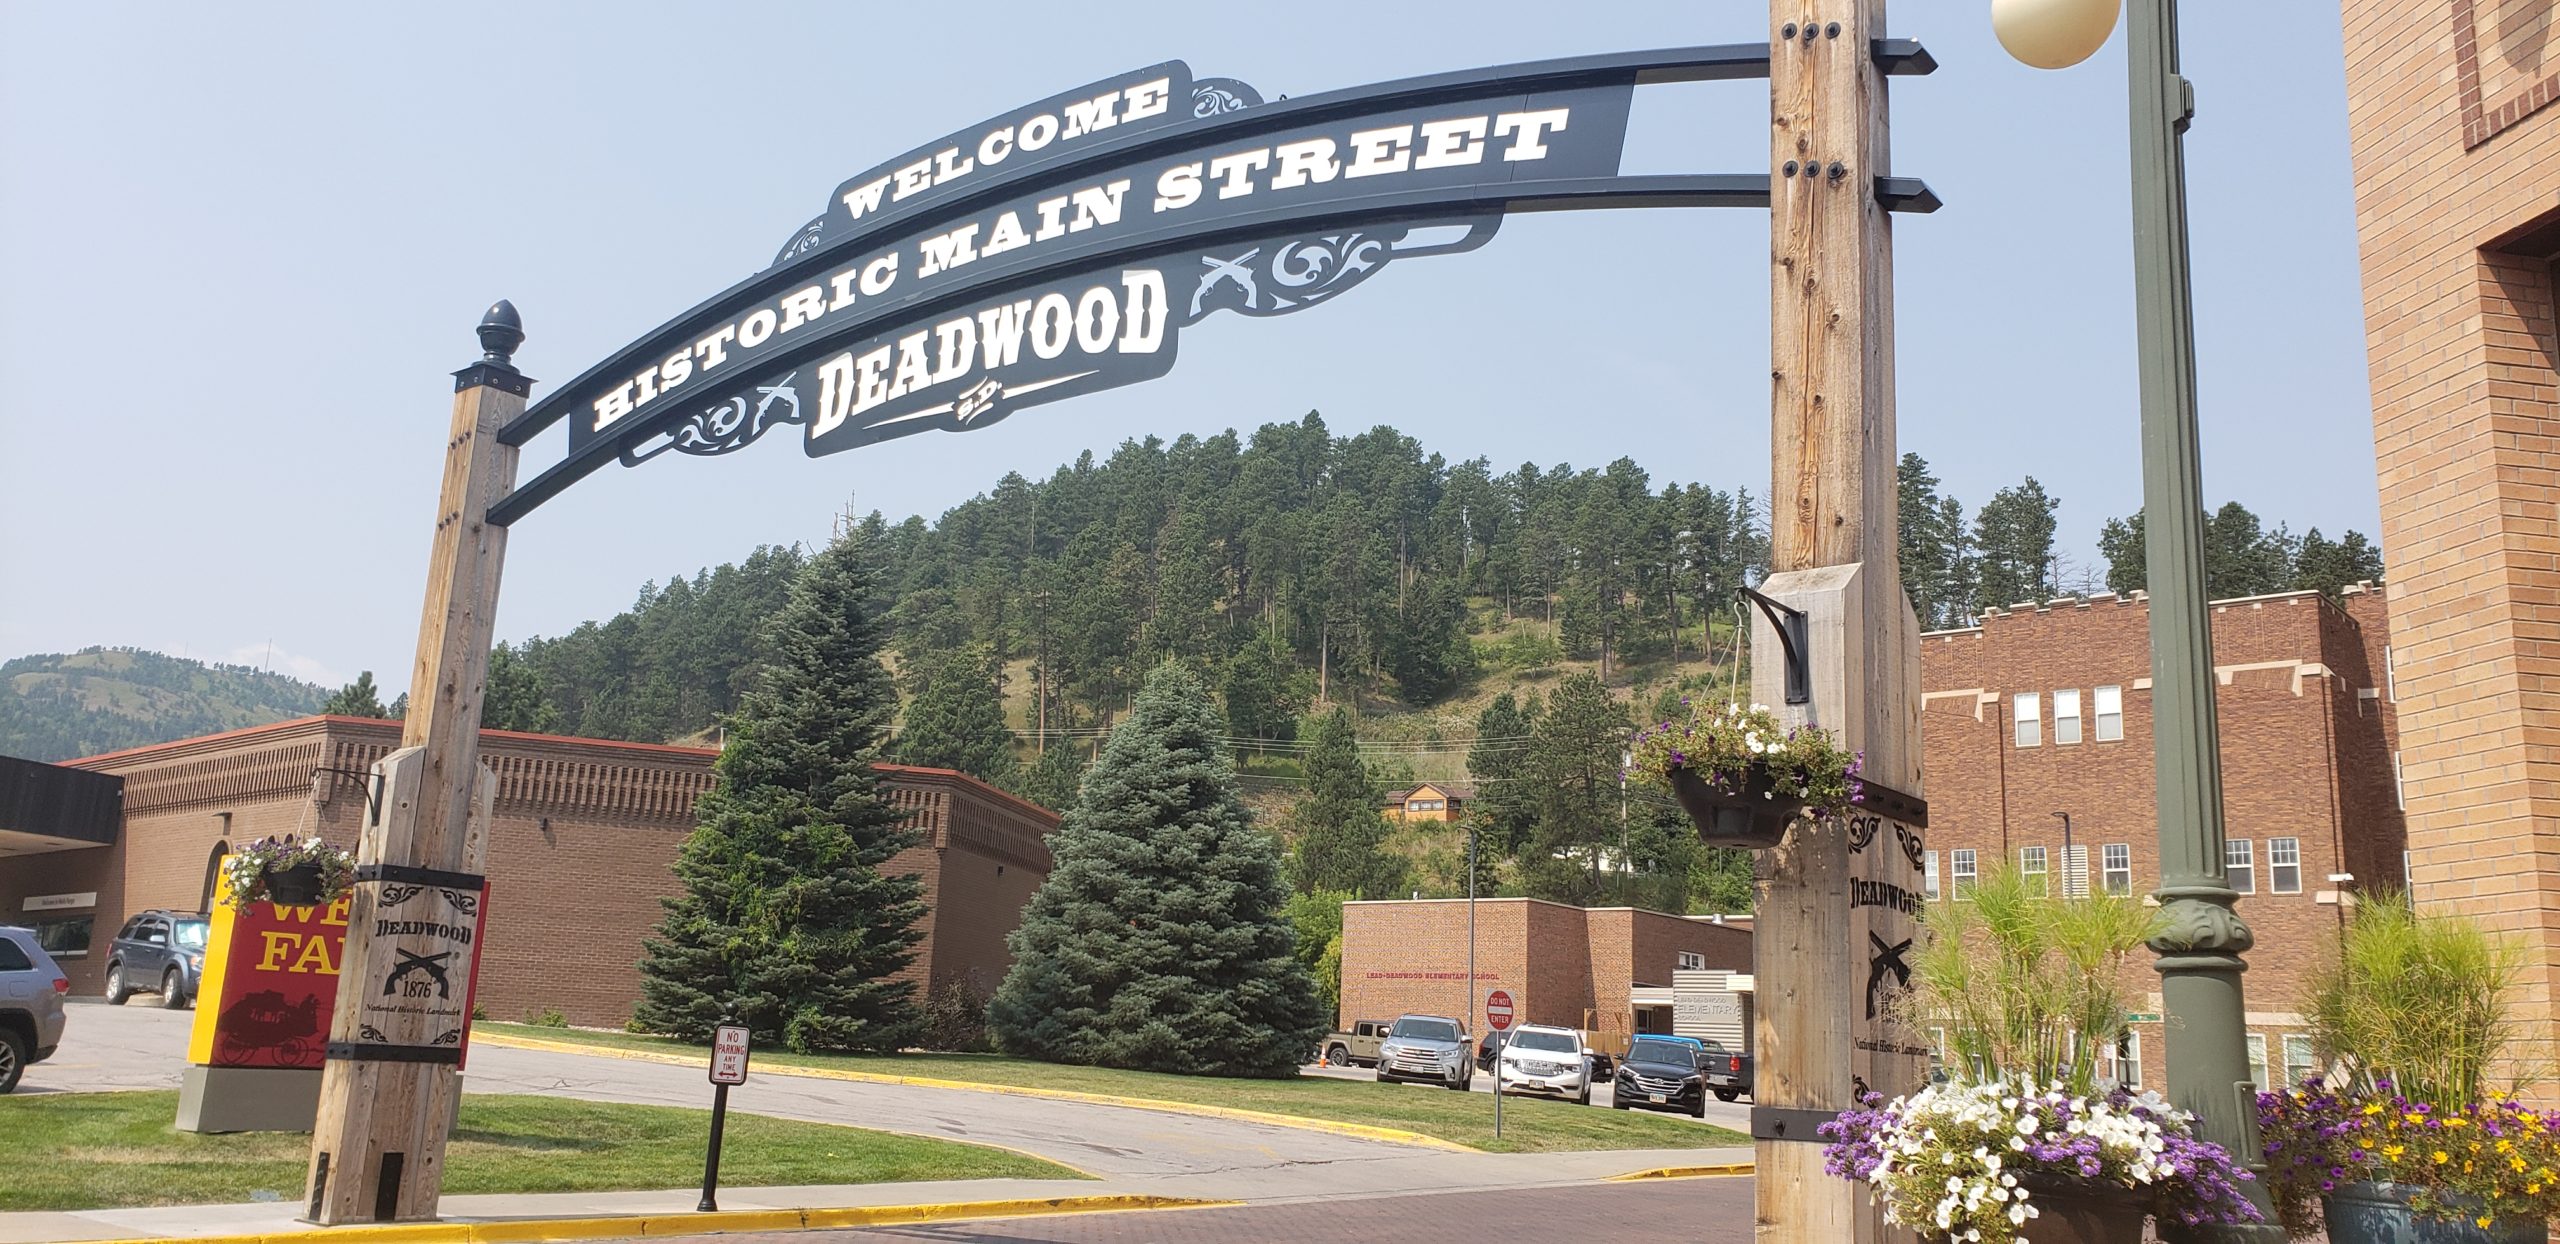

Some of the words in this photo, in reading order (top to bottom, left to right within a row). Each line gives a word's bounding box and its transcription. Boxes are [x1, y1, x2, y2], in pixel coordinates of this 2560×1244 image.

[842, 77, 1171, 220] WELCOME
[593, 252, 899, 433] HISTORIC
[917, 178, 1132, 280] MAIN
[1154, 108, 1570, 213] STREET
[812, 269, 1171, 439] DEADWOOD
[957, 380, 1003, 421] S.D.
[375, 919, 472, 945] DEADWOOD
[256, 931, 346, 975] FA
[1425, 972, 1469, 981] ELEMENTARY
[402, 980, 432, 999] 1876
[1490, 997, 1498, 1005] DO
[1498, 998, 1511, 1006] NOT
[365, 1003, 397, 1014] National
[397, 1004, 425, 1015] Historic
[1678, 1004, 1738, 1015] ELEMENTARY
[1491, 1015, 1509, 1024] ENTER
[726, 1032, 739, 1043] NO
[717, 1043, 745, 1056] PARKING
[723, 1055, 737, 1063] ANY
[722, 1063, 736, 1071] TIME
